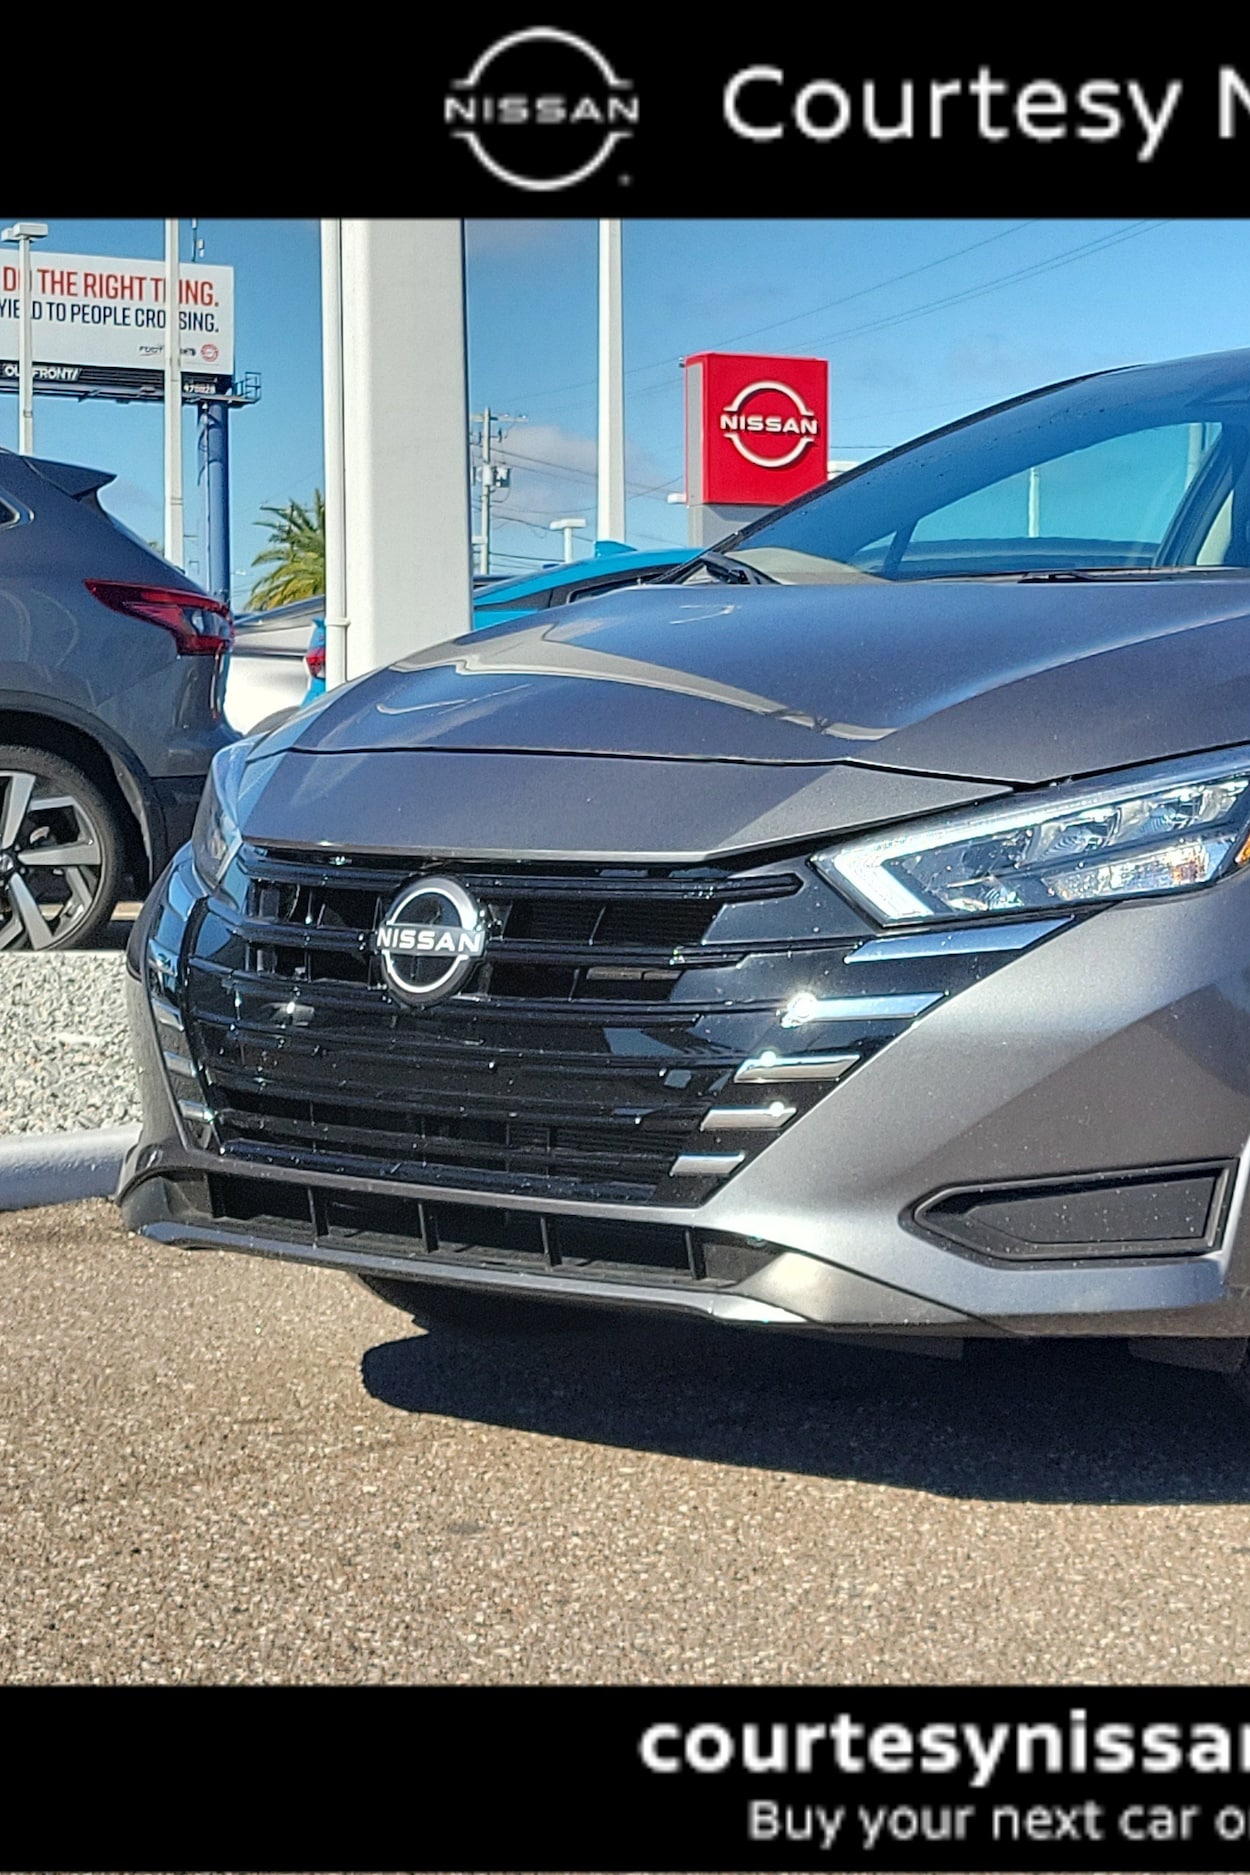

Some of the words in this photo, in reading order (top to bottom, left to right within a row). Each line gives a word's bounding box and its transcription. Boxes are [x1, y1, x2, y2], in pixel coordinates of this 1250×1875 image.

[3, 266, 32, 292] D
[37, 268, 78, 297] THE
[83, 272, 148, 302] RIGHT
[150, 276, 220, 308] TING.
[0, 297, 43, 320] YIED
[46, 301, 66, 322] TO
[71, 304, 131, 327] PEOPLE
[134, 308, 220, 334] CROSING.
[720, 414, 818, 435] NISSAN
[376, 927, 481, 953] NISSAN
